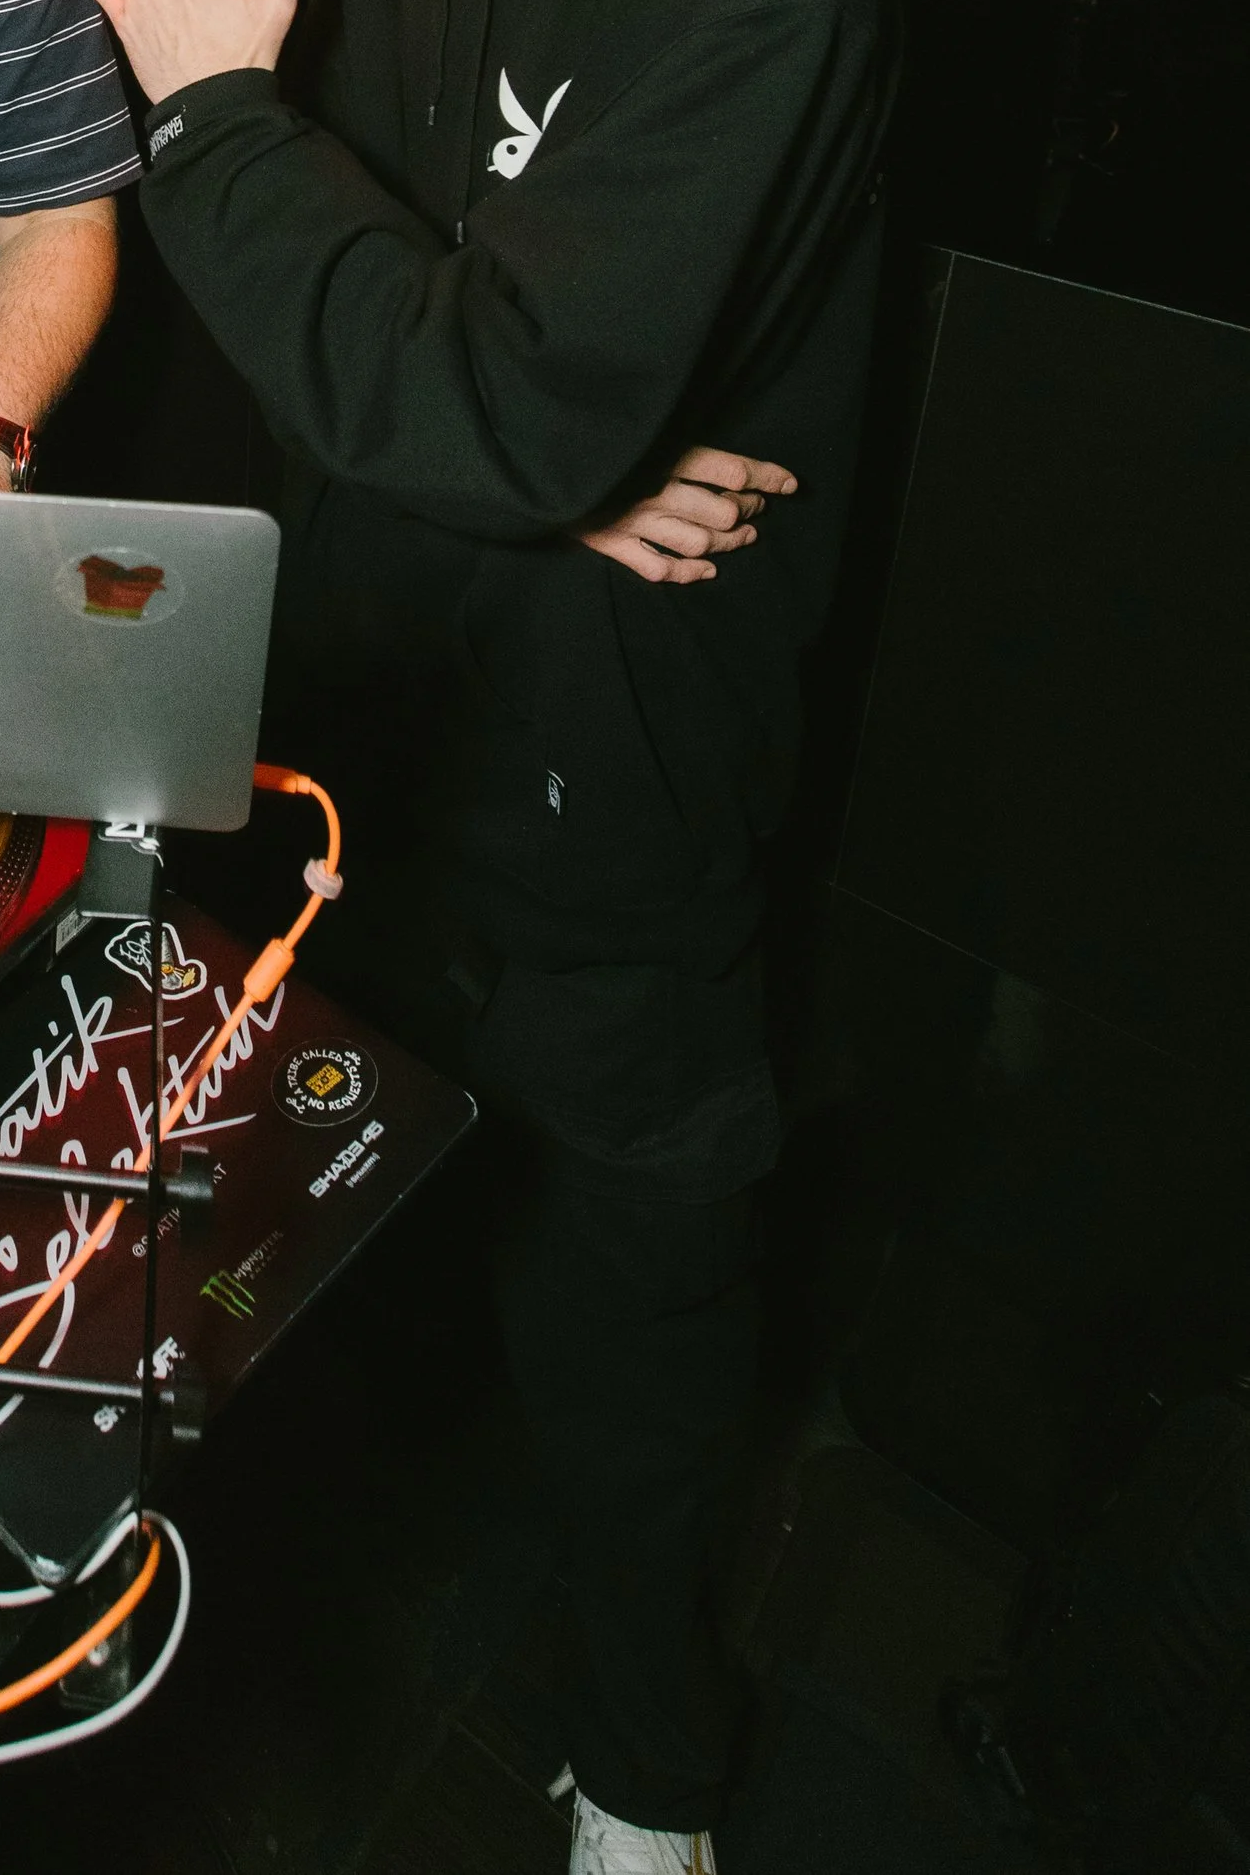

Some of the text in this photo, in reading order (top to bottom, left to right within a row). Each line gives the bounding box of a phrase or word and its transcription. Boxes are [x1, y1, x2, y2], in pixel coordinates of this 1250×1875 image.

[287, 1057, 303, 1088] TRIBE
[302, 1049, 343, 1063] CALLED
[307, 1097, 325, 1111] NO
[309, 1140, 366, 1198] SHADE
[362, 1119, 385, 1144] 45
